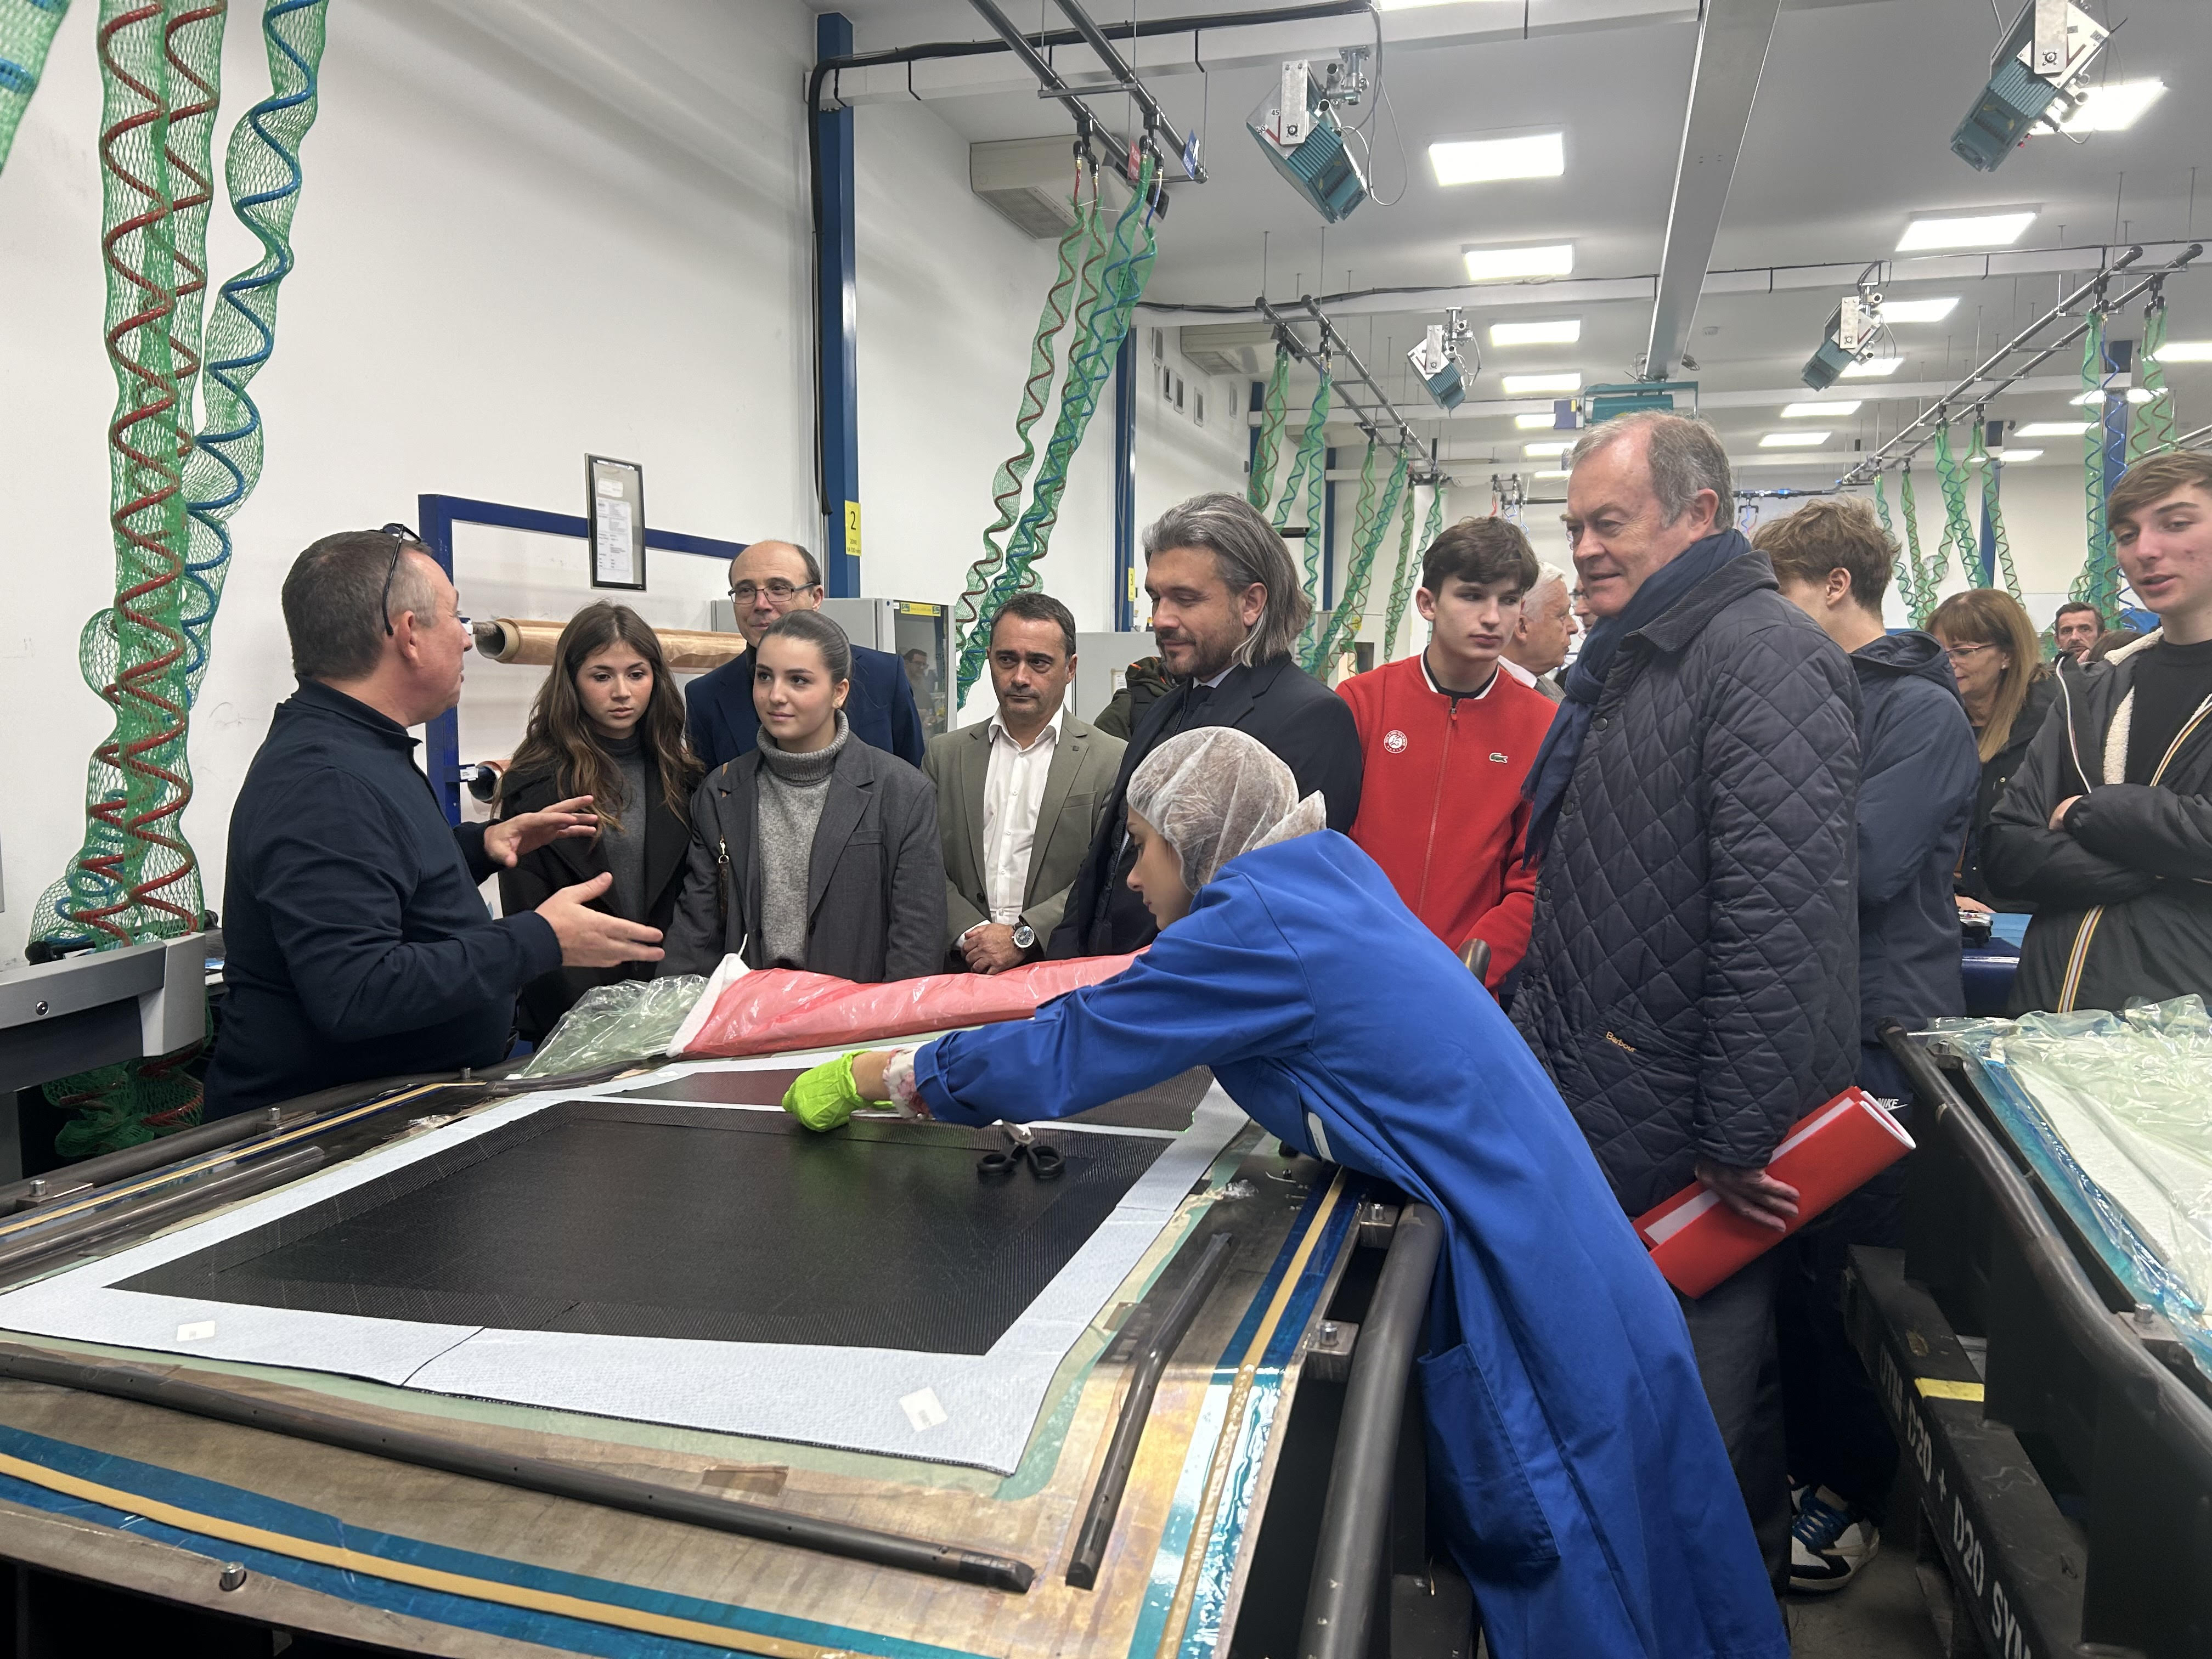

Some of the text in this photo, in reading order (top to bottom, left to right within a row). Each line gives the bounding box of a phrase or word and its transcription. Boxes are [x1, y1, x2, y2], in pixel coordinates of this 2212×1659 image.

[850, 510, 856, 531] 2
[1606, 1031, 1638, 1053] Barbour
[1877, 1098, 1899, 1108] NIKE
[1954, 1494, 1984, 1597] D20
